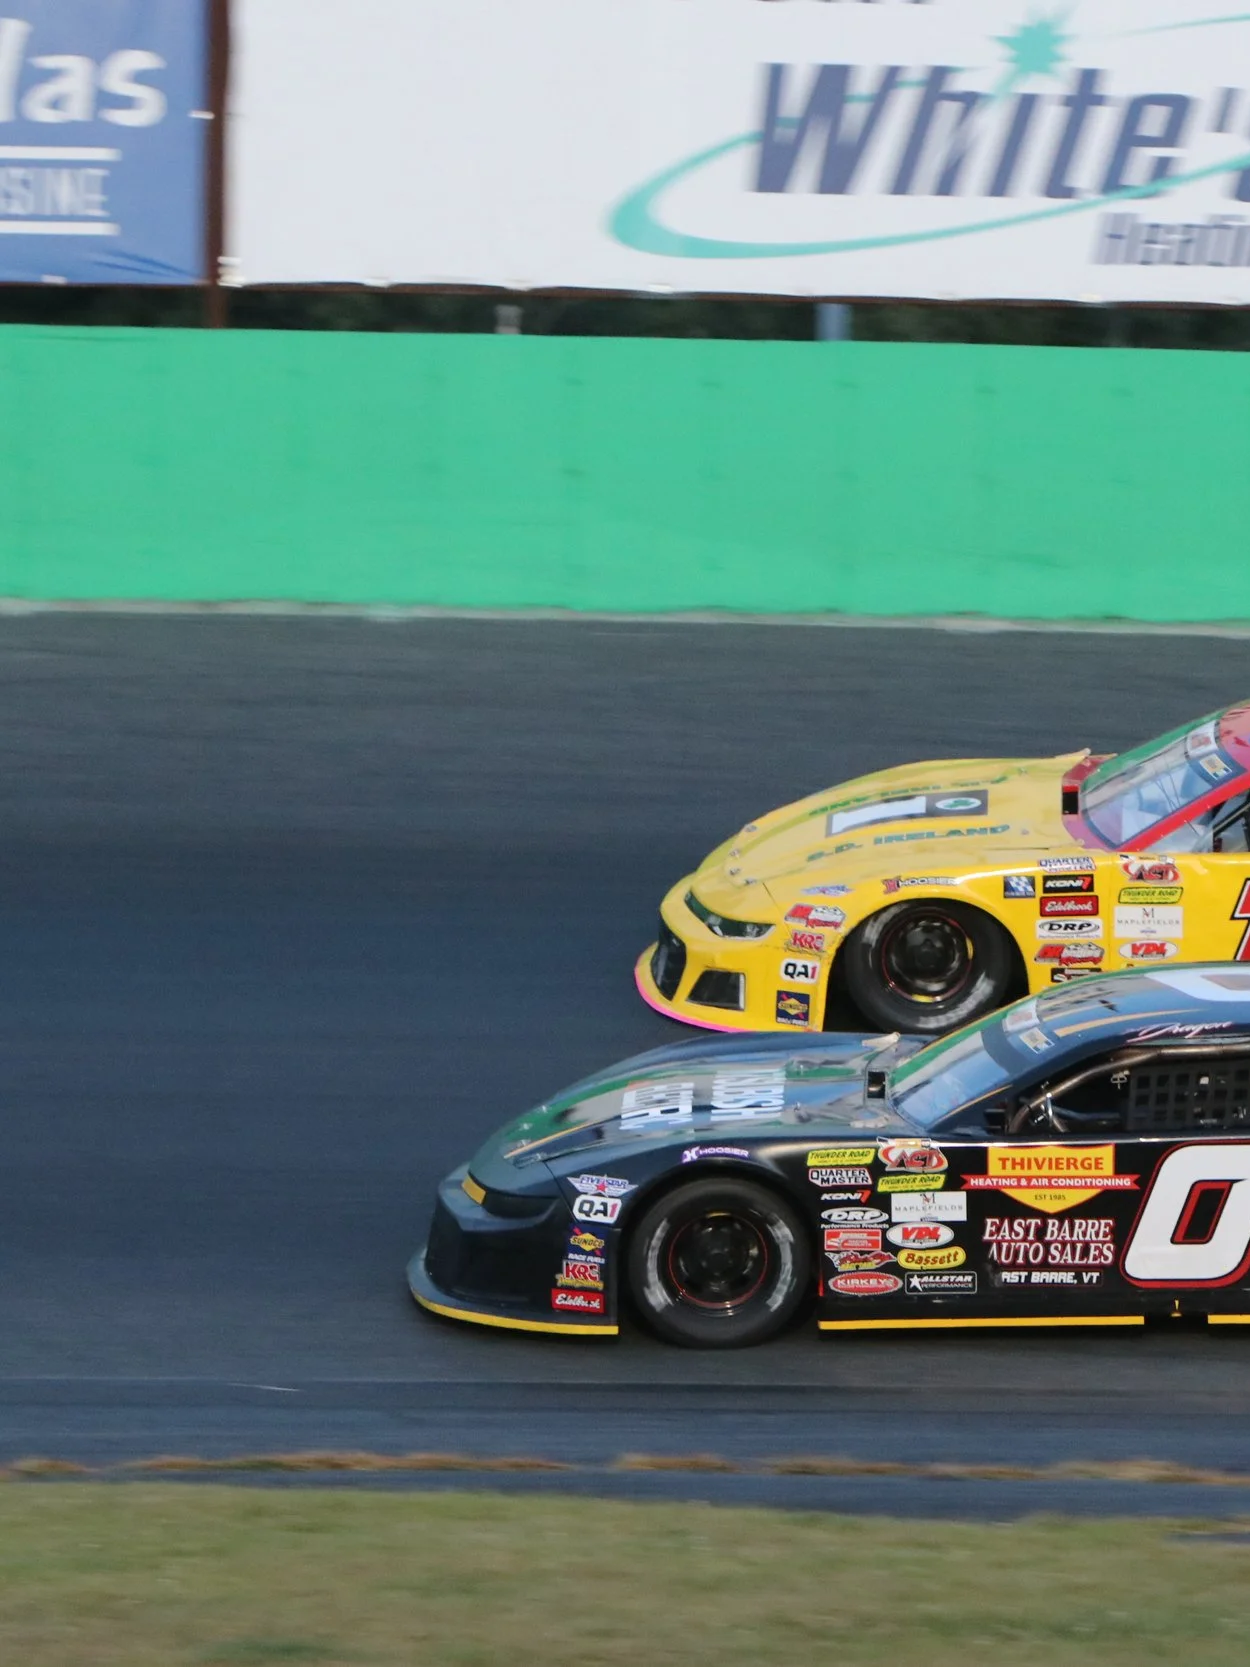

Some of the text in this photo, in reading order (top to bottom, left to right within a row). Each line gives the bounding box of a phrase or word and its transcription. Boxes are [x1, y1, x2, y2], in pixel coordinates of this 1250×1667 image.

[874, 824, 1010, 845] IRELAND
[899, 877, 958, 888] HOOSIER
[1048, 923, 1092, 931] DRP
[784, 962, 818, 979] QA1
[700, 1147, 749, 1158] HOOSIER
[811, 1150, 870, 1159] THUNDER ROAD
[998, 1157, 1104, 1171] THIVIERGE
[811, 1169, 866, 1180] QUARTER
[821, 1177, 869, 1185] MASTER
[881, 1175, 941, 1185] THUNDER ROAD
[970, 1178, 1131, 1187] HEATING & AIR CONDITIONING
[578, 1199, 618, 1217] QA1
[829, 1211, 881, 1220] DRP
[983, 1218, 1113, 1241] EAST BARRE
[570, 1235, 605, 1249] SUNOCO
[905, 1251, 959, 1265] Bassett
[988, 1242, 1114, 1265] AUTO SALES
[564, 1262, 600, 1282] KRC
[999, 1271, 1100, 1284] AST BARRE, VT
